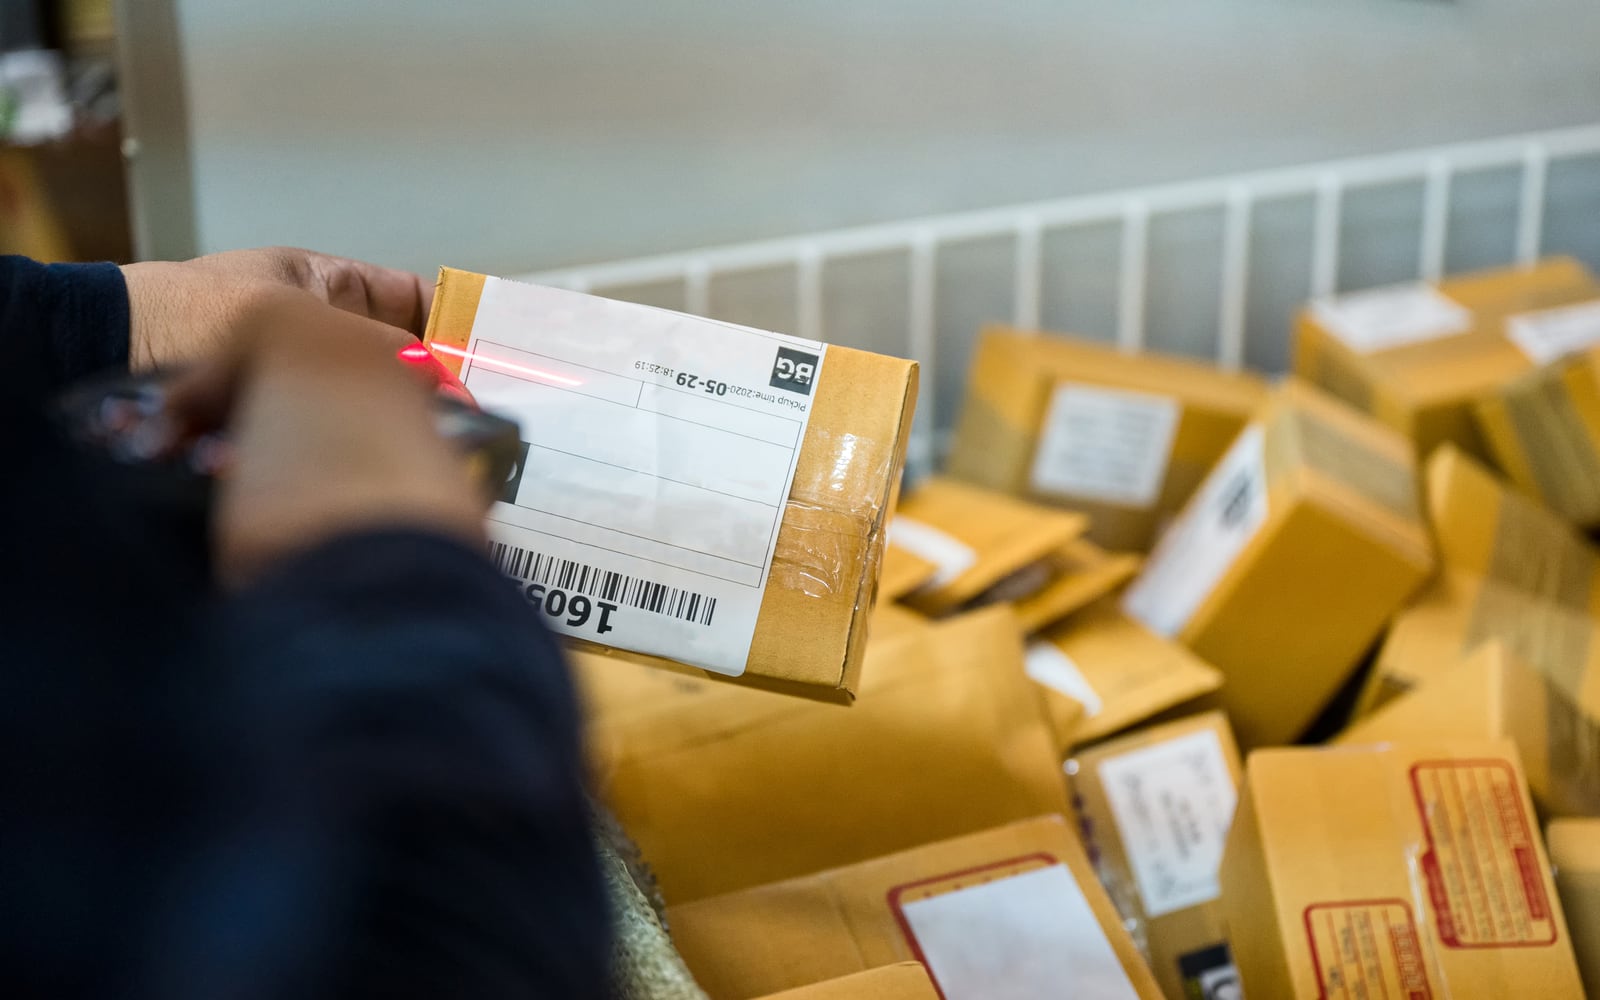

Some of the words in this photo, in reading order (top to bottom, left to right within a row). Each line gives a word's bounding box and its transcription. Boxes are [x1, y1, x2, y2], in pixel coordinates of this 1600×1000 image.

[634, 360, 675, 378] 18:25:19
[777, 396, 807, 412] Pickup
[514, 577, 618, 634] 1605
